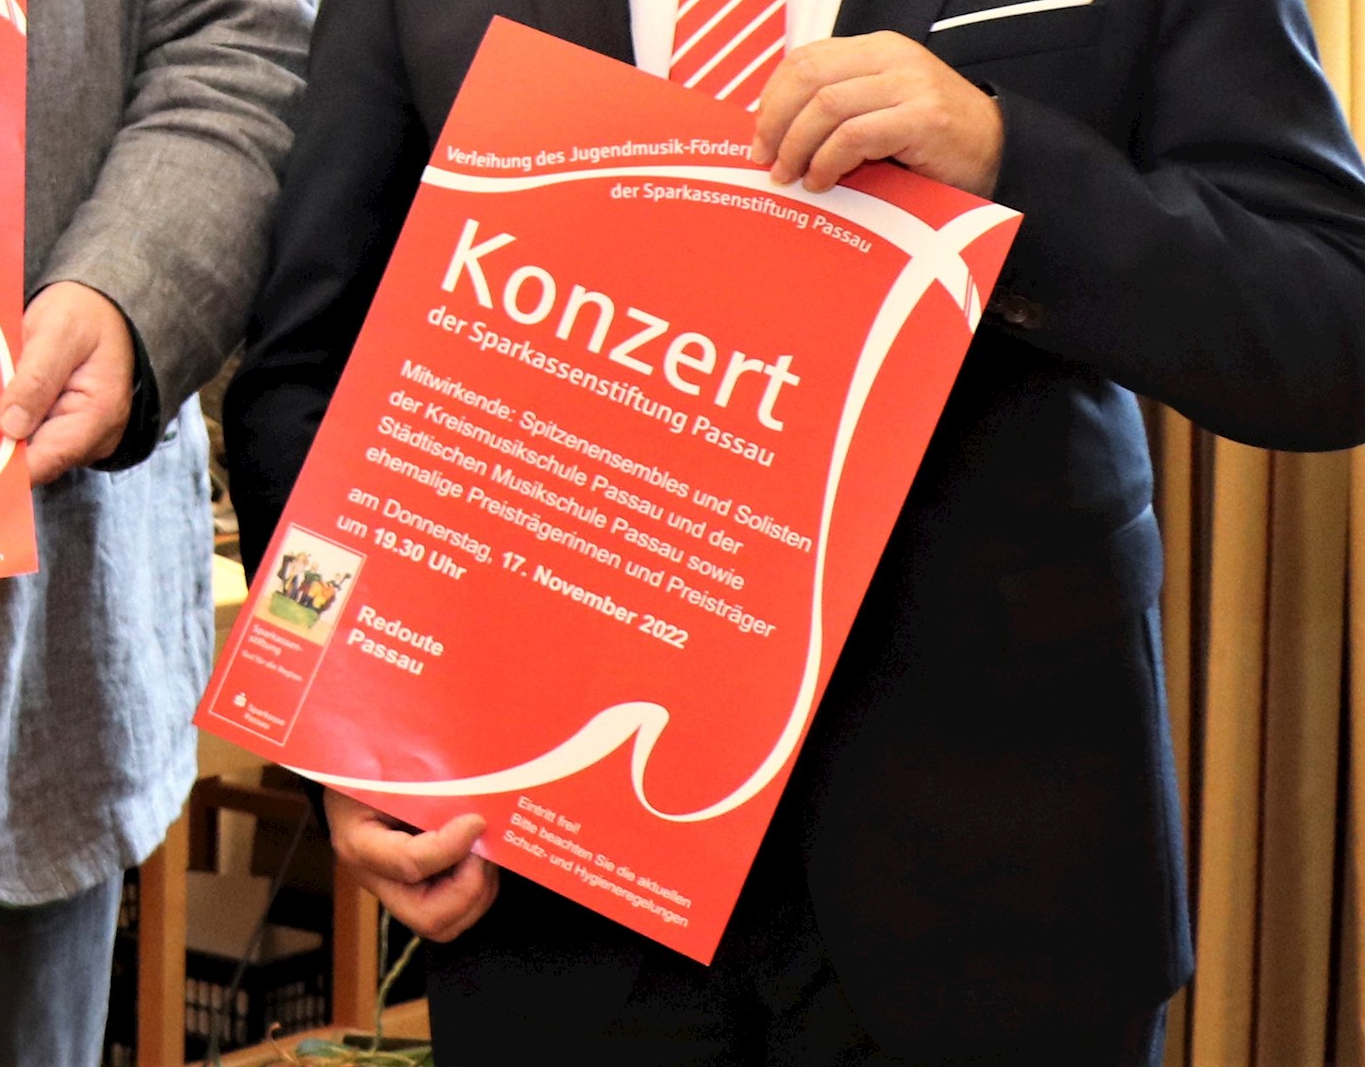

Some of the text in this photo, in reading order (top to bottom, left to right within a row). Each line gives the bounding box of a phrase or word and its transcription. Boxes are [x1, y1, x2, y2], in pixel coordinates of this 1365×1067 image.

[447, 145, 532, 171] Verleihung
[535, 150, 566, 166] des
[610, 182, 872, 253] der Sparkassenstiftung Passau
[428, 305, 775, 467] der Sparkassenstiftung Passau
[441, 219, 801, 432] Konzert
[378, 415, 745, 590] Städtischen Musikschule Passau sowie
[389, 390, 744, 555] der Kreismusikschule Passau und der
[401, 359, 812, 553] Mitwirkende: Spitzenensembles und Solisten
[337, 515, 467, 580] um 19.30 Uhr
[348, 488, 689, 649] am Donnerstag, 17. November 2022
[366, 447, 776, 637] ehemalige Preisträgerinnen und Preisträger
[347, 628, 424, 675] Passau
[357, 605, 444, 656] Redoute
